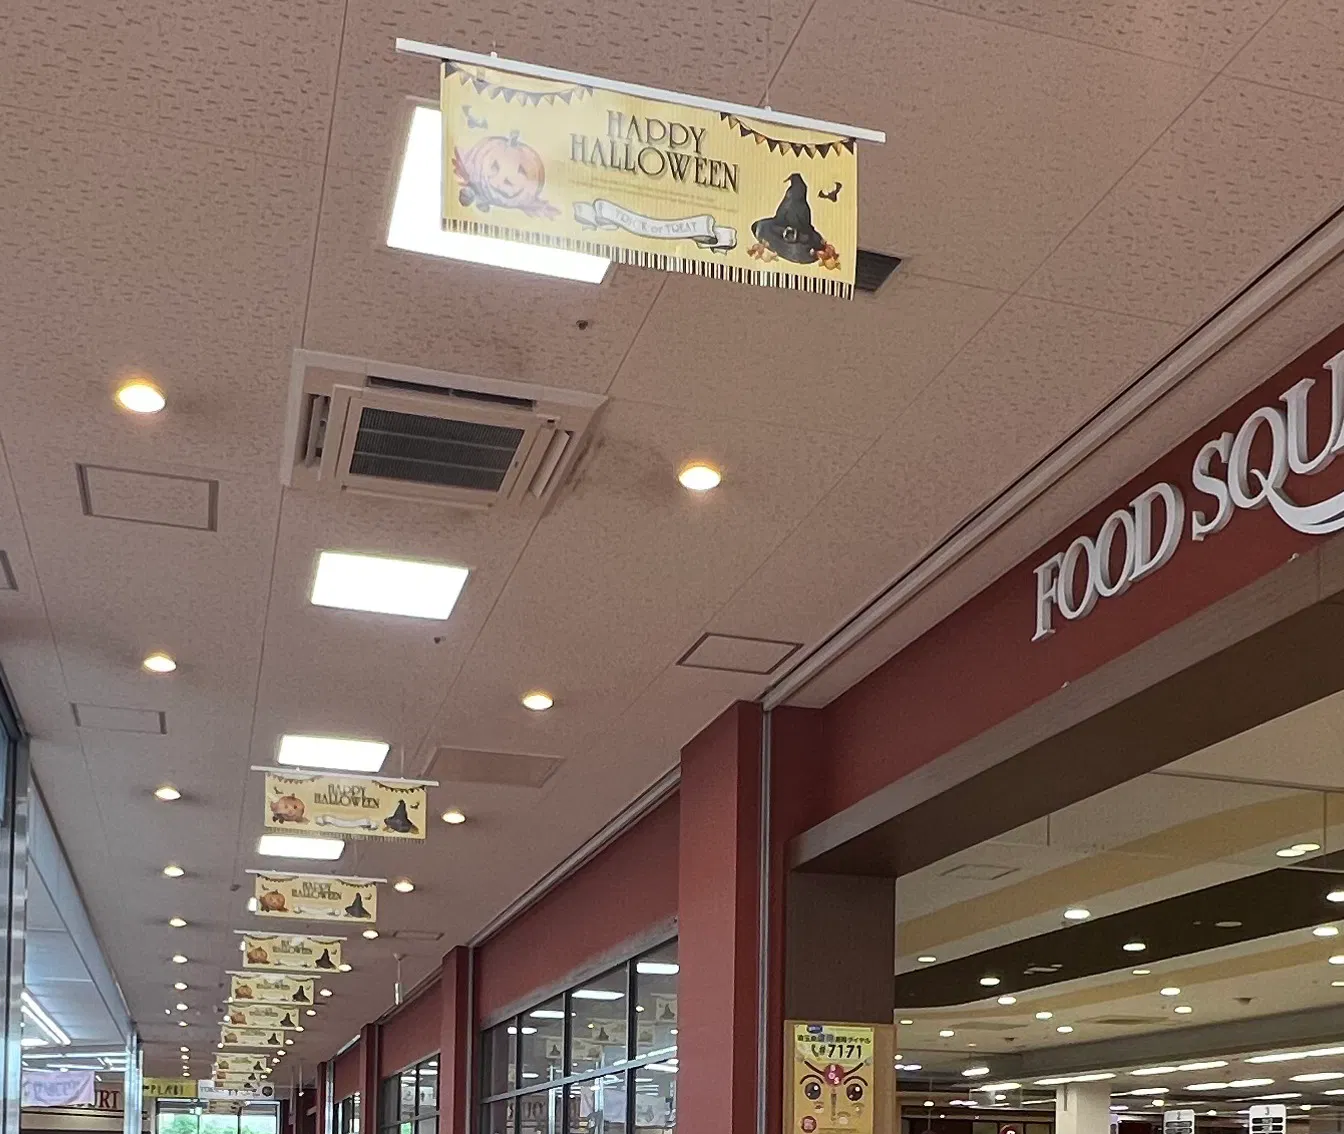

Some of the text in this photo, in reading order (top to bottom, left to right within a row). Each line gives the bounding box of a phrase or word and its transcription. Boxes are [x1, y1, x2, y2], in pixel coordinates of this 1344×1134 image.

[607, 109, 706, 154] HAPPY
[570, 132, 739, 194] HALLOWEEN
[1031, 481, 1185, 643] FOOD
[314, 793, 380, 809] HALLOWEEN
[327, 784, 367, 797] HAPPY
